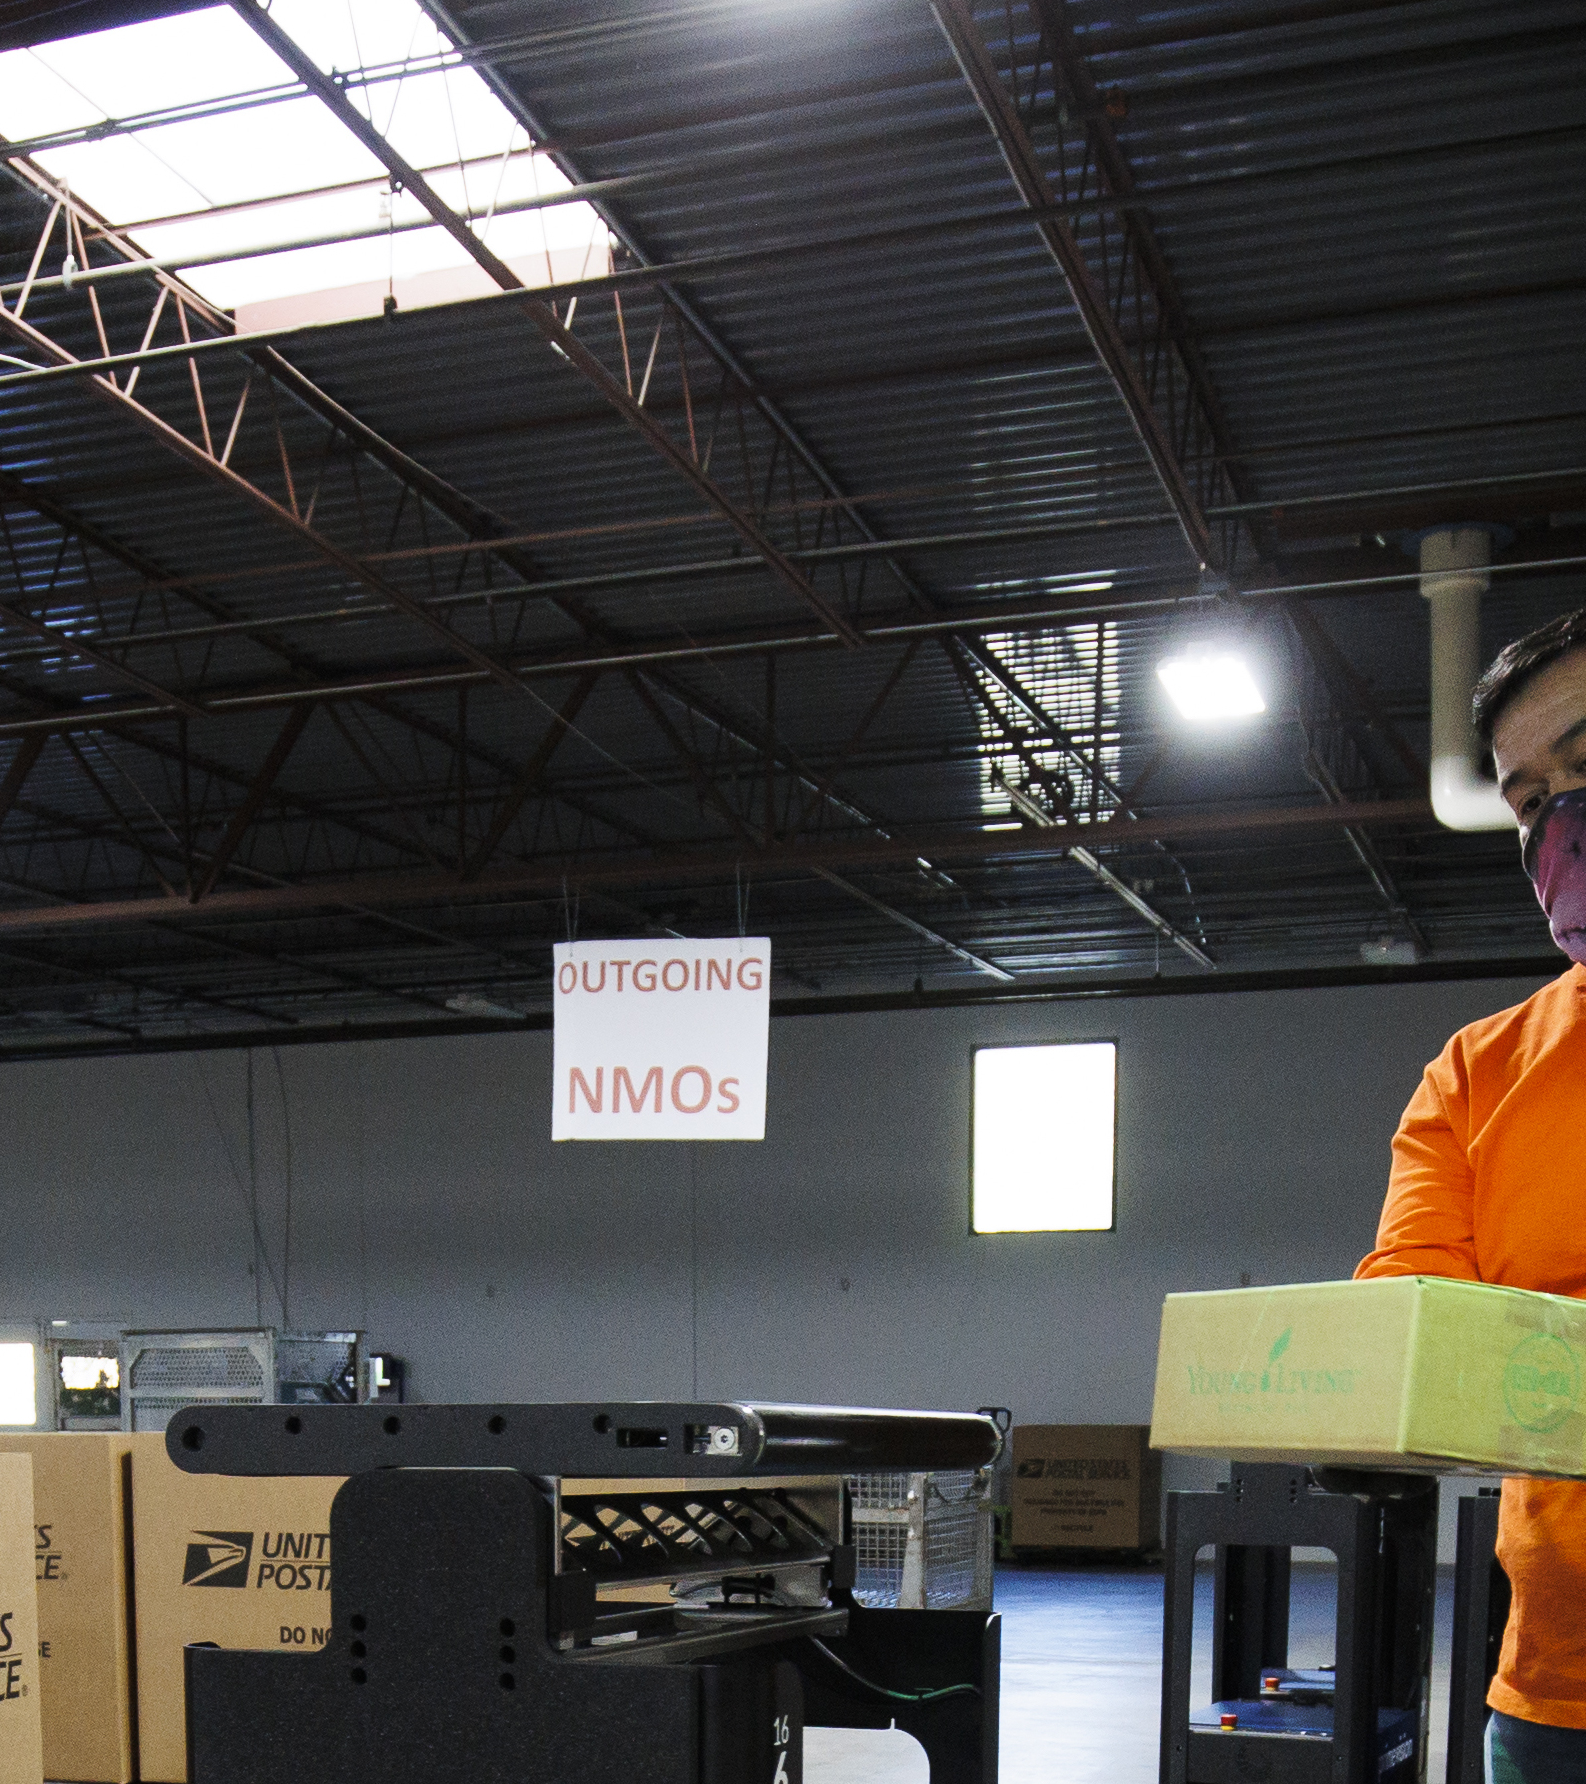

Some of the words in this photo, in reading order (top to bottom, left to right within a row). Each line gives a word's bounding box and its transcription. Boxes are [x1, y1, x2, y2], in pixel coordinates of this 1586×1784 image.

[558, 957, 763, 994] OUTGOING
[569, 1065, 740, 1113] NMOs
[262, 1531, 330, 1559] UNIT
[280, 1626, 306, 1644] DO
[773, 1714, 790, 1746] 16
